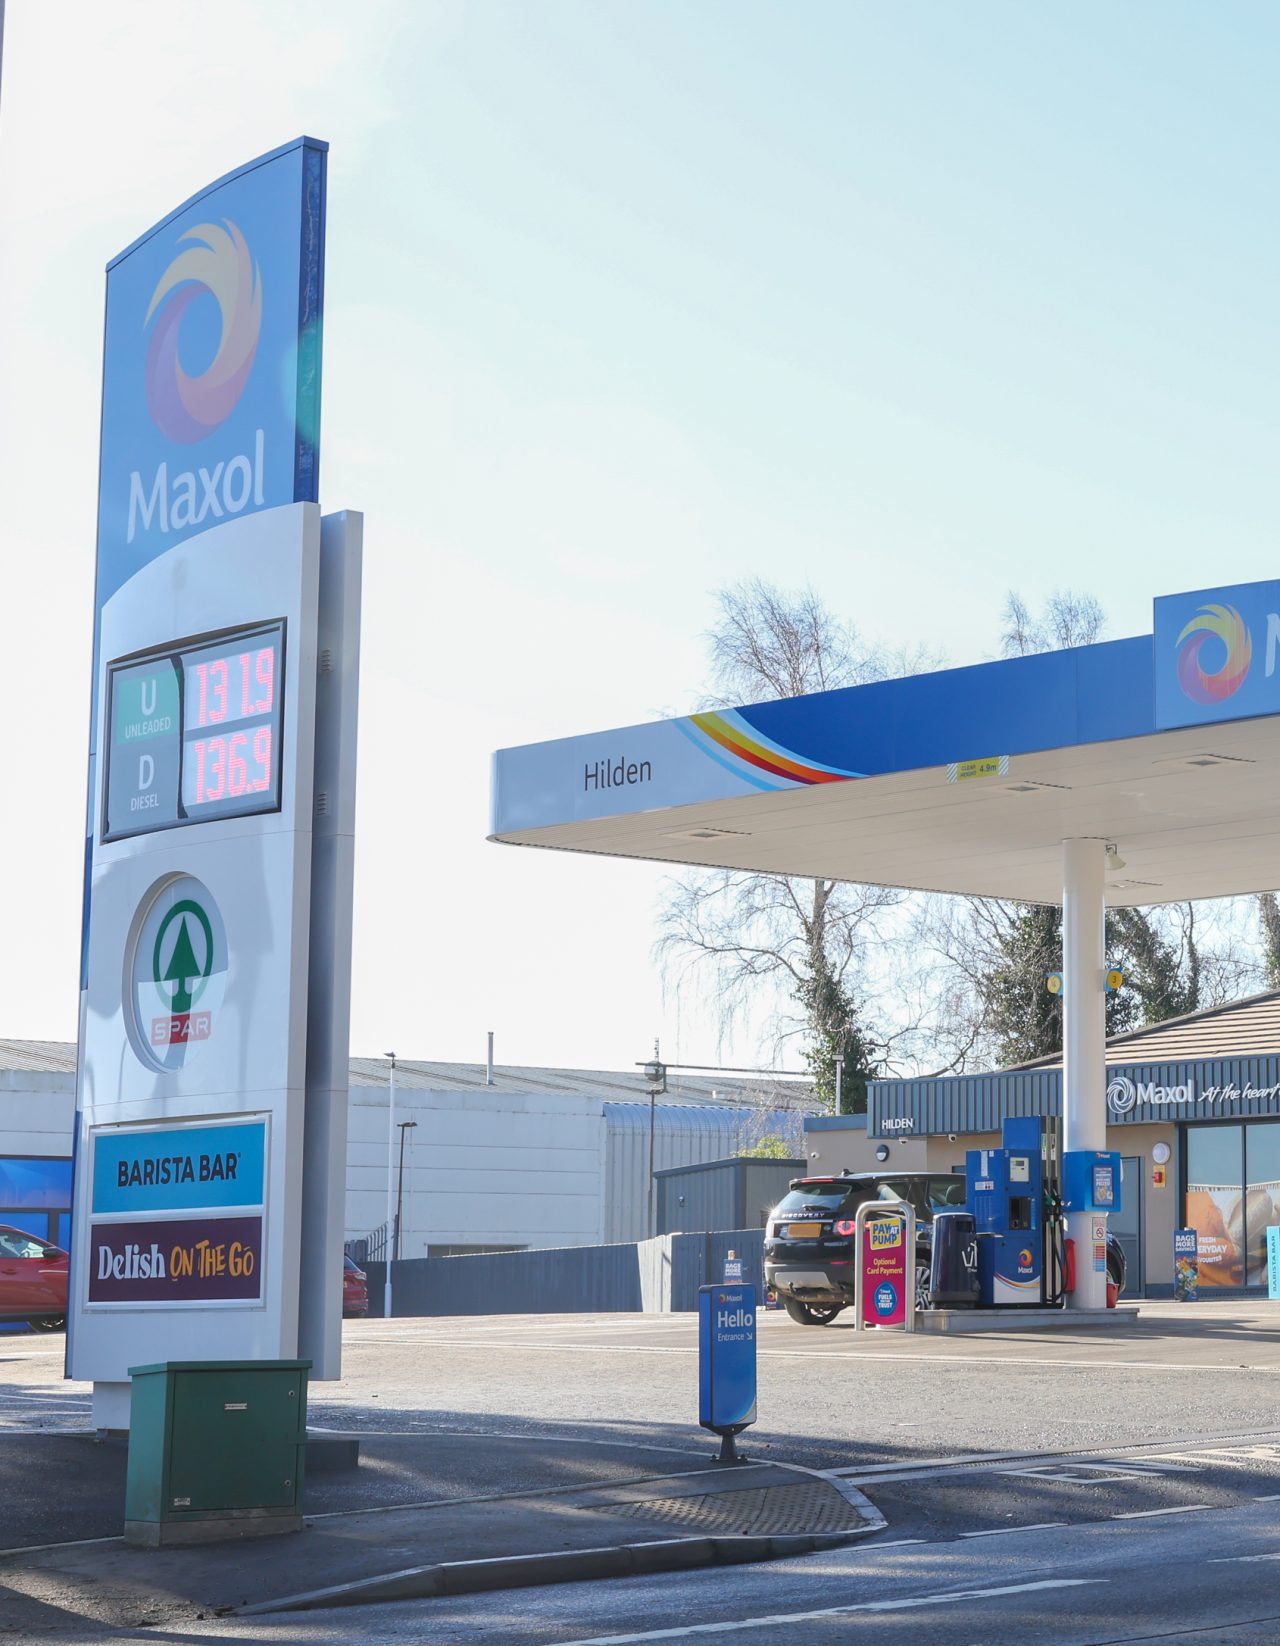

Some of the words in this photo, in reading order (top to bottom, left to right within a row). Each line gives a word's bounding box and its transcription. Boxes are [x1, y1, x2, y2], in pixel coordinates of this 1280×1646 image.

[127, 429, 265, 544] Maxol
[141, 679, 156, 716] U
[125, 717, 171, 740] UNLEADED
[138, 754, 155, 791] D
[195, 728, 273, 805] 136.9
[583, 756, 652, 792] Hilden
[130, 795, 160, 812] DIESEL
[153, 1017, 210, 1042] SPAR
[1136, 1079, 1195, 1105] Maxol
[1198, 1086, 1220, 1103] At
[1220, 1082, 1240, 1102] the
[1242, 1081, 1279, 1099] heart
[881, 1118, 914, 1130] HILDEN
[117, 1156, 195, 1187] BARISTA
[199, 1152, 238, 1181] BAR
[872, 1234, 897, 1245] PUMP
[873, 1224, 891, 1235] PAY
[890, 1226, 899, 1235] AT
[97, 1244, 166, 1280] Delish
[170, 1246, 194, 1282] ON
[196, 1240, 226, 1278] THE
[867, 1267, 880, 1275] Card
[880, 1267, 903, 1276] Payment
[873, 1258, 896, 1267] Optional
[1018, 1266, 1033, 1274] Maxol
[726, 1294, 742, 1302] Maxol
[717, 1309, 753, 1329] Hello
[717, 1332, 744, 1342] Entrance
